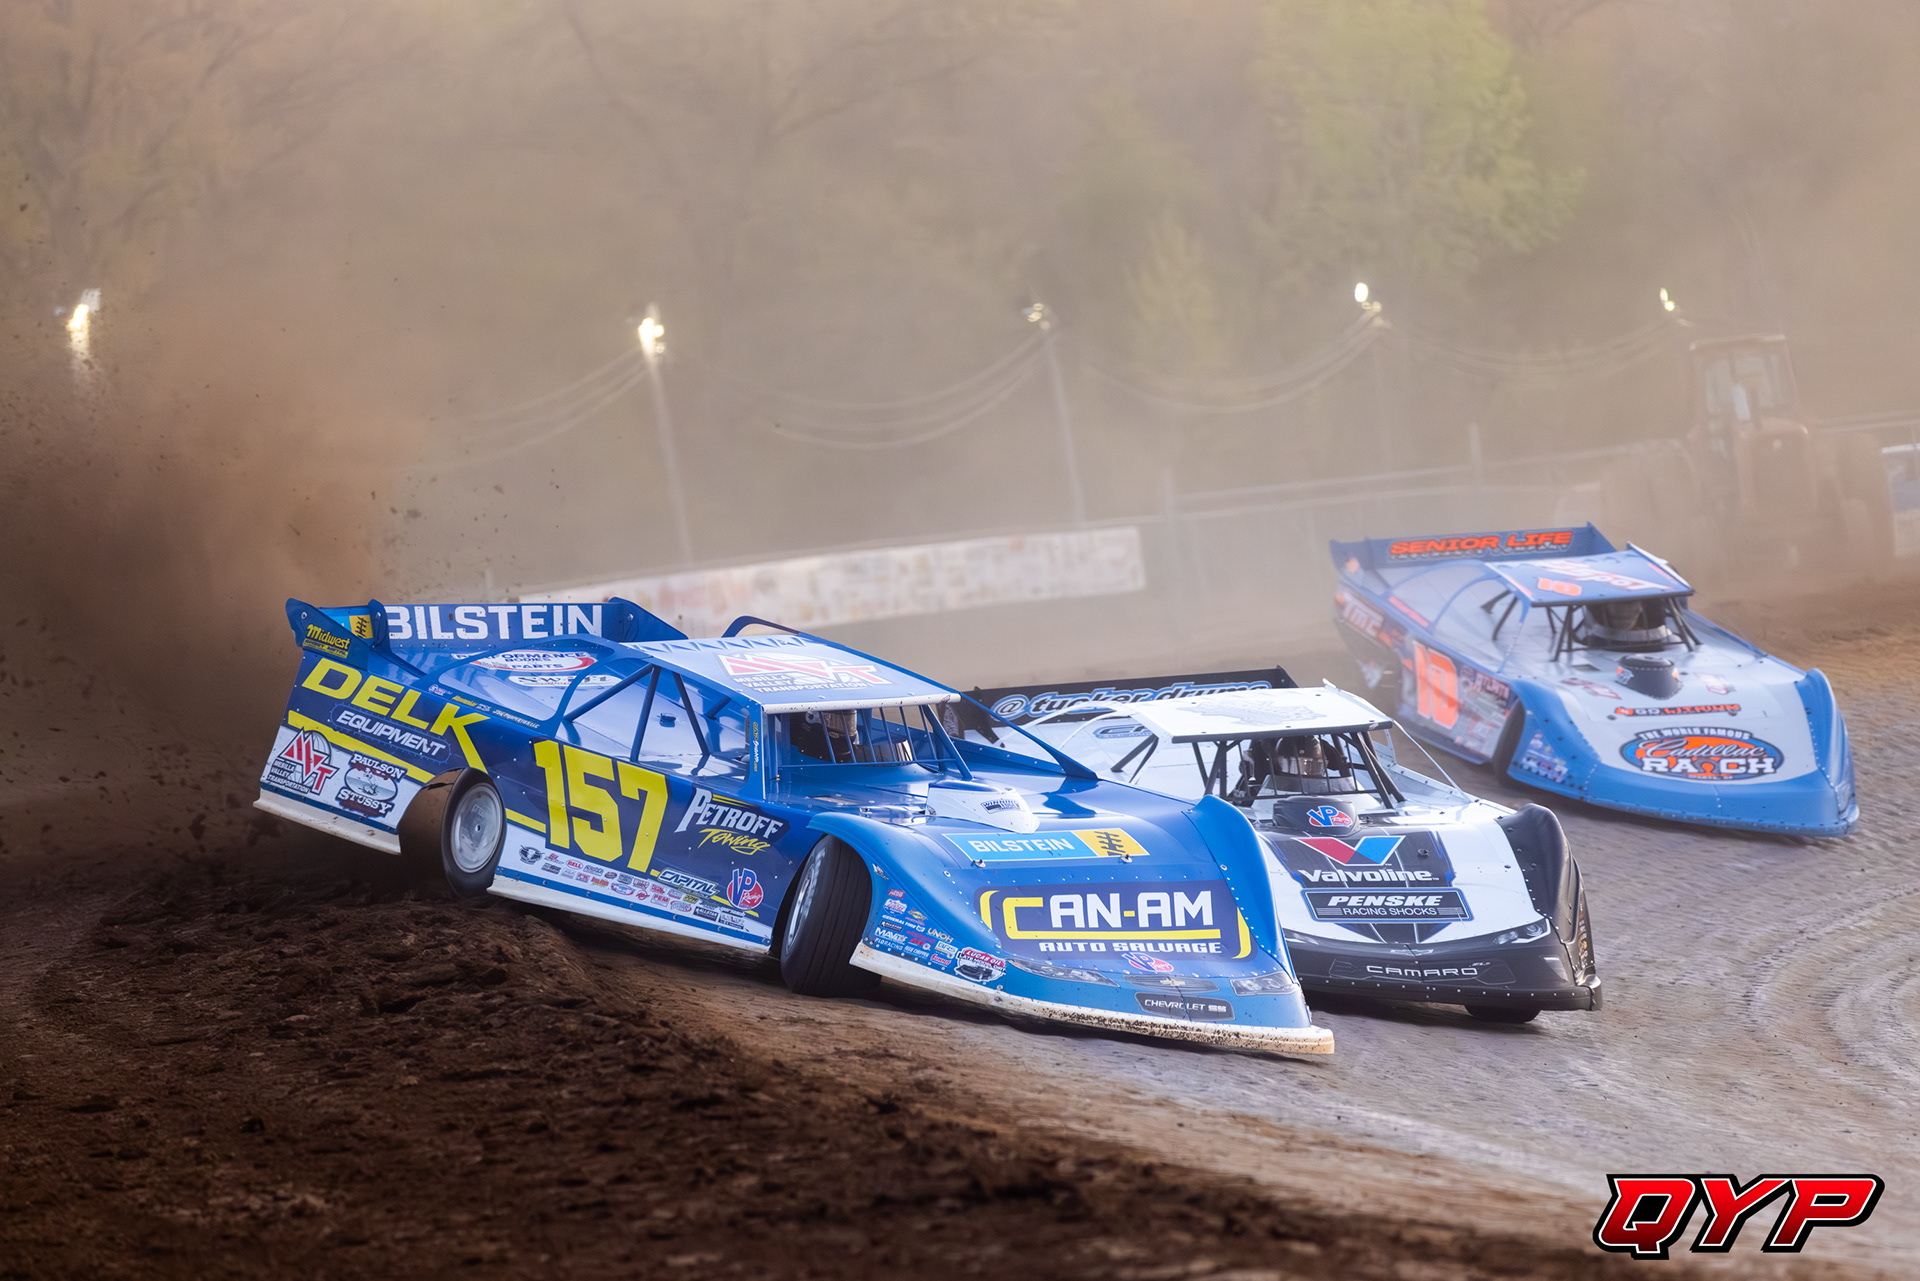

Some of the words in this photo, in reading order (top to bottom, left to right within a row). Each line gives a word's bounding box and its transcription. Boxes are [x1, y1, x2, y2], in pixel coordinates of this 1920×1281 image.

[1390, 535, 1500, 555] SENIOR
[1506, 531, 1573, 547] LIFE
[383, 605, 602, 640] BILSTEIN
[306, 623, 351, 650] Midwest
[511, 662, 564, 670] PARTS
[733, 673, 793, 684] MESILLA
[742, 680, 794, 690] VALLEY
[754, 682, 871, 694] TRANSPORTATION
[301, 657, 491, 777] DELK
[335, 710, 446, 757] EQUIPMENT
[1639, 731, 1661, 740] THE
[1661, 727, 1701, 736] WORLD
[1704, 727, 1750, 740] FAMOUS
[1638, 736, 1767, 758] Cadillac
[270, 767, 290, 779] VALLEY
[274, 760, 295, 772] MESILLA
[351, 754, 406, 780] PAULSON
[267, 775, 310, 794] TRANSPORTATION
[337, 789, 393, 814] STUSSY
[534, 740, 668, 874] 157
[674, 787, 784, 839] PETROFF
[1307, 806, 1338, 826] VP
[698, 828, 771, 855] Towing
[972, 838, 1076, 853] BILSTEIN
[567, 860, 582, 869] BELL
[660, 870, 713, 895] CAPITAL
[1298, 868, 1433, 883] Valvoline
[732, 867, 758, 908] VP
[1328, 895, 1443, 907] PENSKE
[1003, 890, 1222, 940] CAN-AM
[1342, 907, 1388, 916] RACING
[1389, 907, 1438, 916] SHOCKS
[1039, 942, 1110, 953] AUTO
[1112, 942, 1223, 954] SALVAGE
[966, 950, 990, 962] LUCAS
[990, 958, 1002, 967] OIL
[1366, 965, 1478, 978] CAMARO
[1144, 999, 1206, 1011] CHEVROLET
[1208, 1004, 1227, 1012] SS
